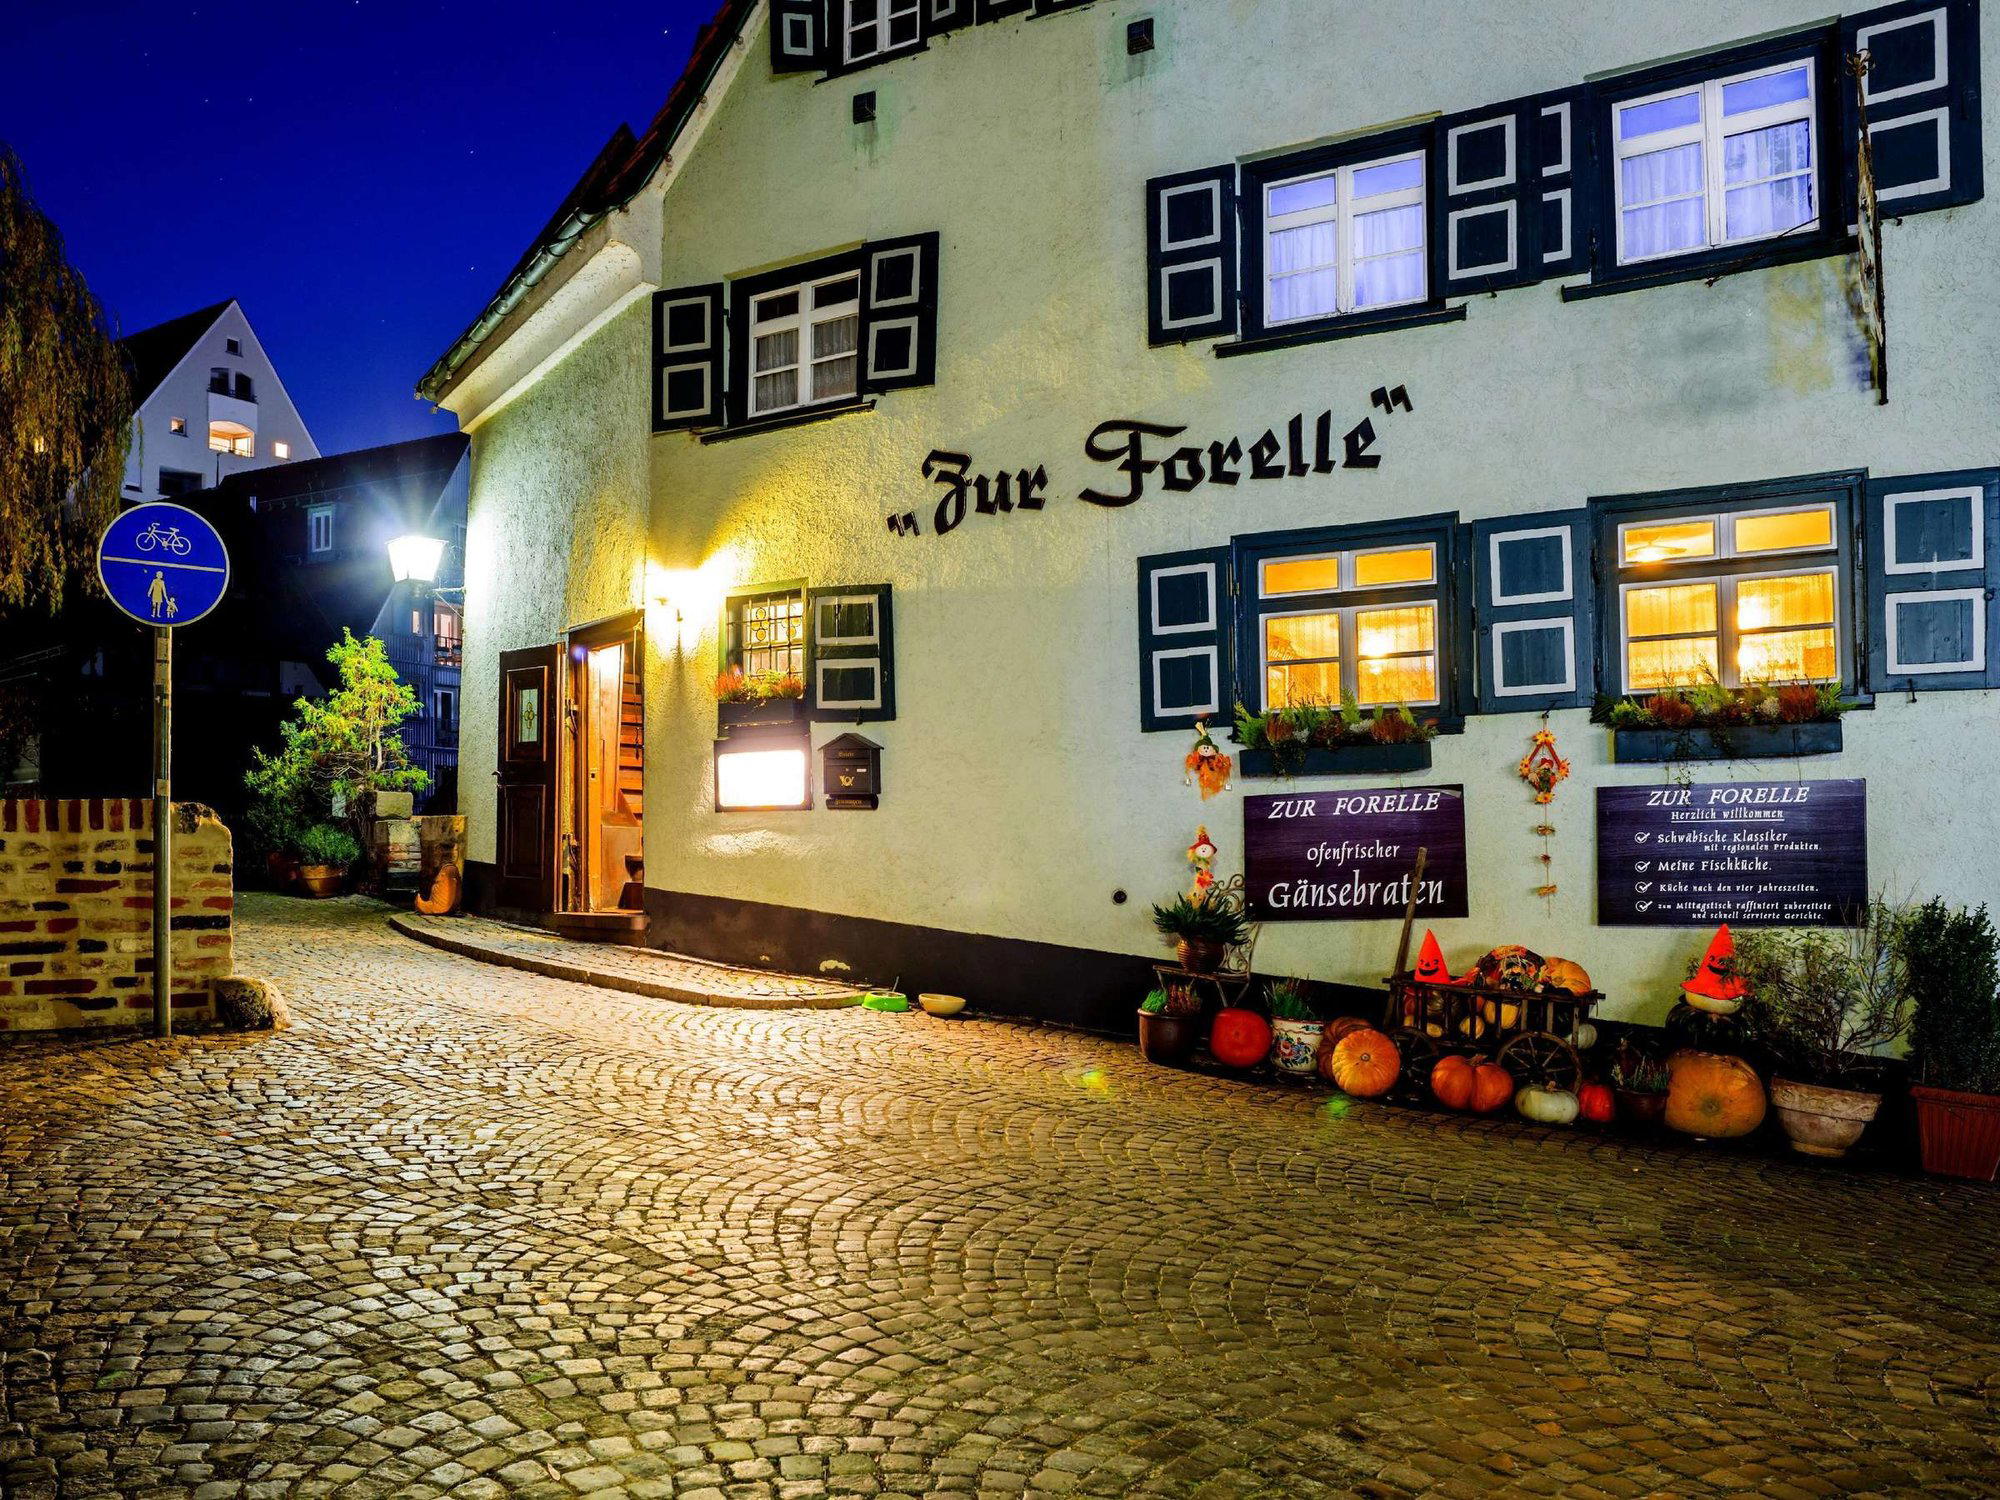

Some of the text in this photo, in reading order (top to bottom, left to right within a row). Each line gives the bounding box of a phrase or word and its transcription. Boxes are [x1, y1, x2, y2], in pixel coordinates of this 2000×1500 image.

[1646, 786, 1810, 806] ZUR FORELLE
[1268, 792, 1441, 819] ZUR FORELLE
[1671, 807, 1784, 820] Herzlich willkommen
[1657, 829, 1788, 843] Schwäbische Klassiker
[1704, 843, 1718, 852] mit
[1722, 842, 1769, 854] regionalen
[1658, 857, 1772, 871] Meine Fischküche.
[1268, 869, 1445, 909] Gänsebraten
[1660, 881, 1689, 892] Küche
[1692, 883, 1713, 892] nach
[1717, 883, 1732, 892] den
[1736, 884, 1754, 892] vier
[1676, 901, 1732, 912] Mittagstisch
[1736, 900, 1779, 912] raffiniert
[1784, 901, 1832, 910] zubereitete
[1692, 911, 1707, 919] und
[1710, 911, 1739, 919] schnell
[1742, 912, 1781, 920] servierte
